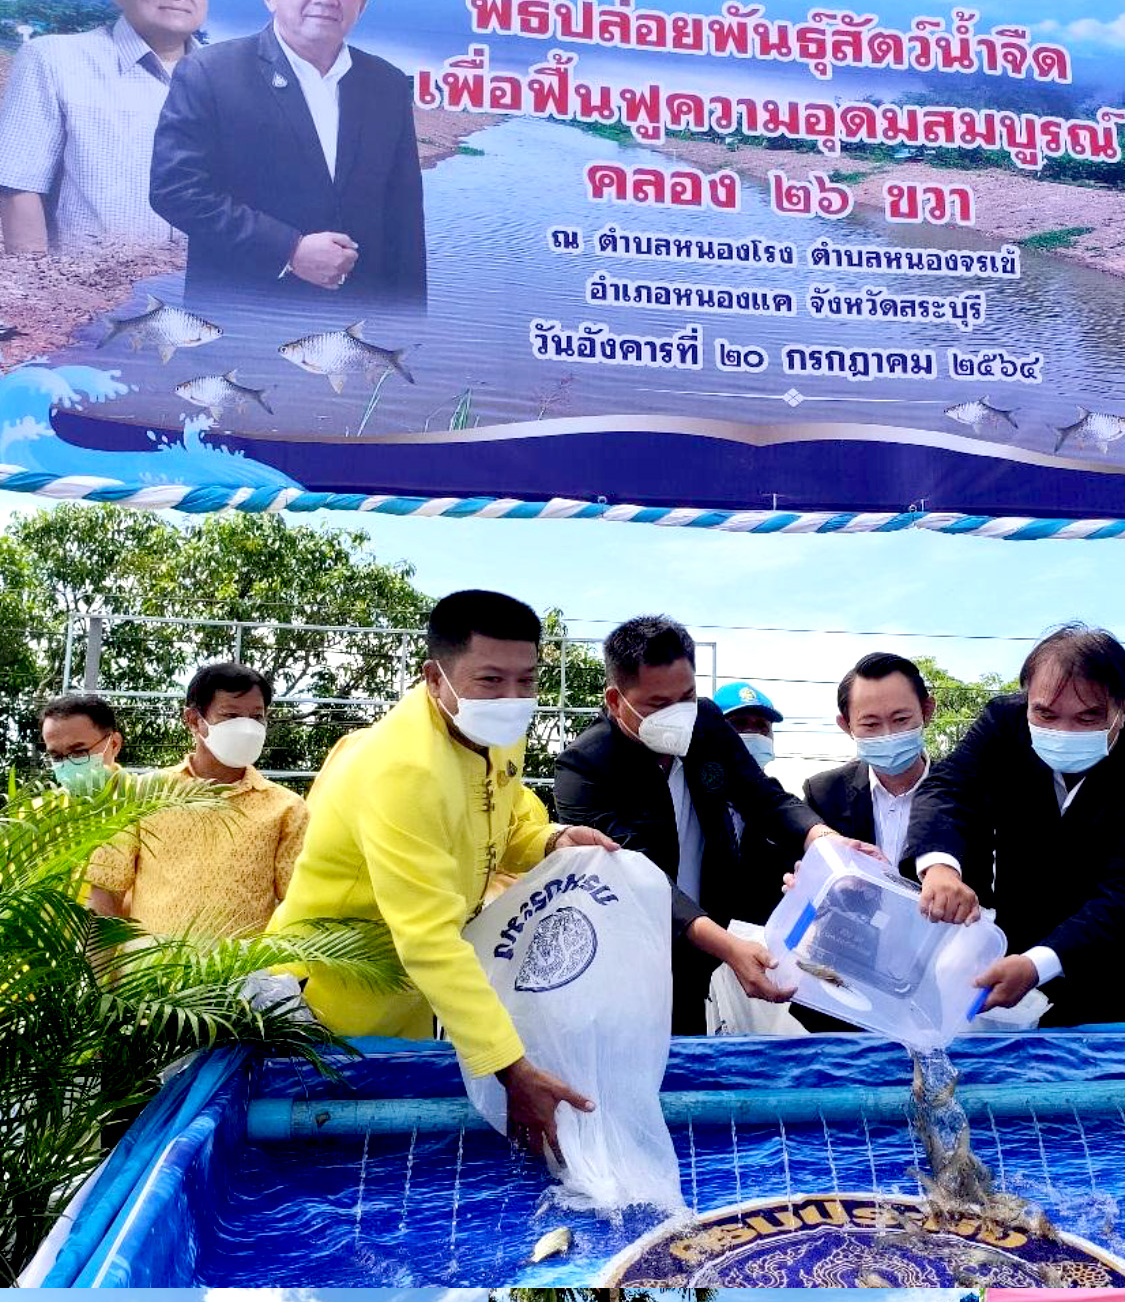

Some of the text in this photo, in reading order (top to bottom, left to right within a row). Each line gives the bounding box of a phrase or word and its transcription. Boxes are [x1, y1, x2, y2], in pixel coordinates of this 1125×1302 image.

[418, 47, 1125, 167] เพื่อฟื้นฟูความอุดมสมบูรณ์
[586, 164, 972, 222] คลอง ๒๖ ขวา
[551, 227, 1016, 274] ณ ตำบลหนองโรง ตำบลหนองจรเข้
[590, 275, 982, 327] อำเภอหนองแค จังหวัดสระบุรี
[534, 323, 1041, 379] วันอังคารที่ ๒๐ กรกฎาคม ๒๕๖๔
